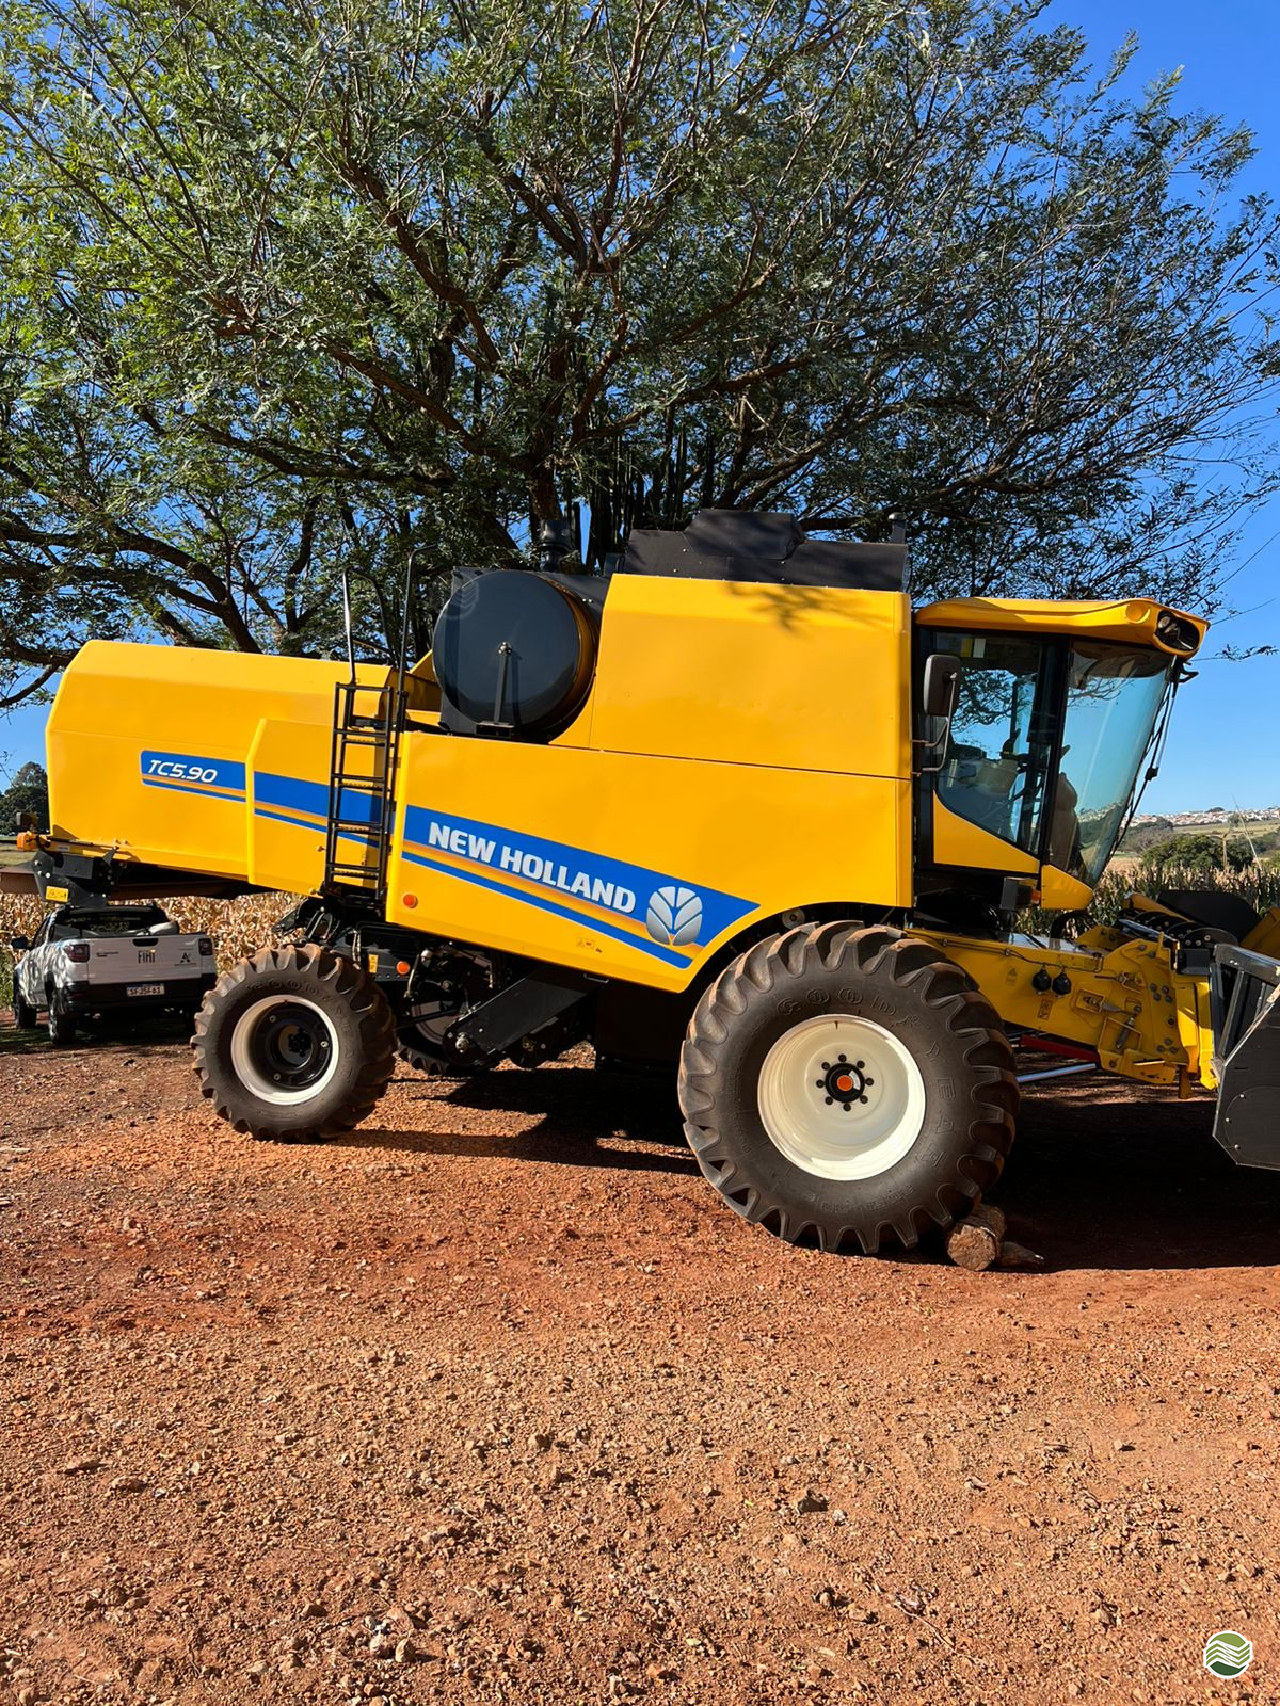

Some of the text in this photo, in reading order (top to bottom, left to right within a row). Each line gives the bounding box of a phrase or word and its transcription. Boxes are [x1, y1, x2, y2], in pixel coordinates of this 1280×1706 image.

[148, 759, 218, 783] TC5.90
[428, 821, 637, 914] NEW HOLLAND
